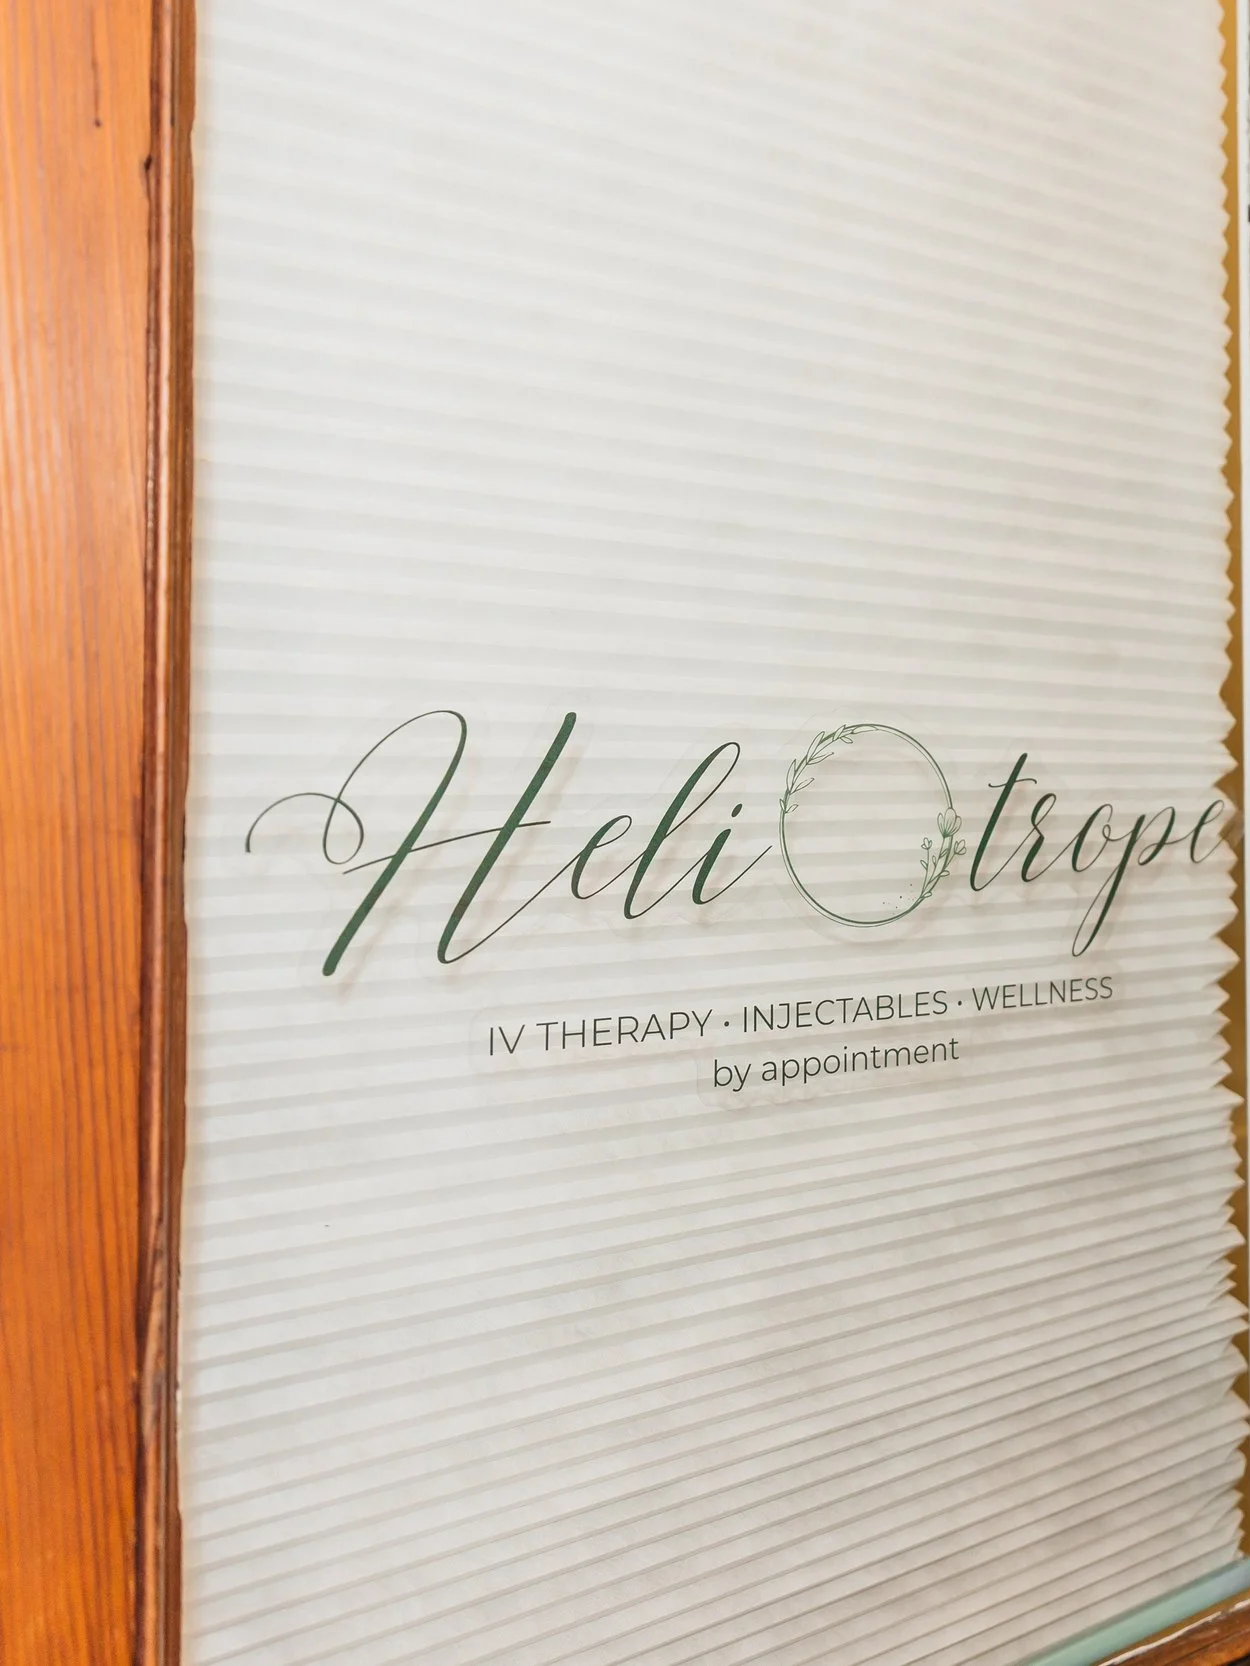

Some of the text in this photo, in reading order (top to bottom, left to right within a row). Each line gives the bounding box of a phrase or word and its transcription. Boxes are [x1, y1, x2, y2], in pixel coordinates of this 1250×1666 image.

[488, 975, 1114, 1057] IV THERAPY INJECTABLES WELLNESS
[712, 1037, 961, 1094] by appointment
